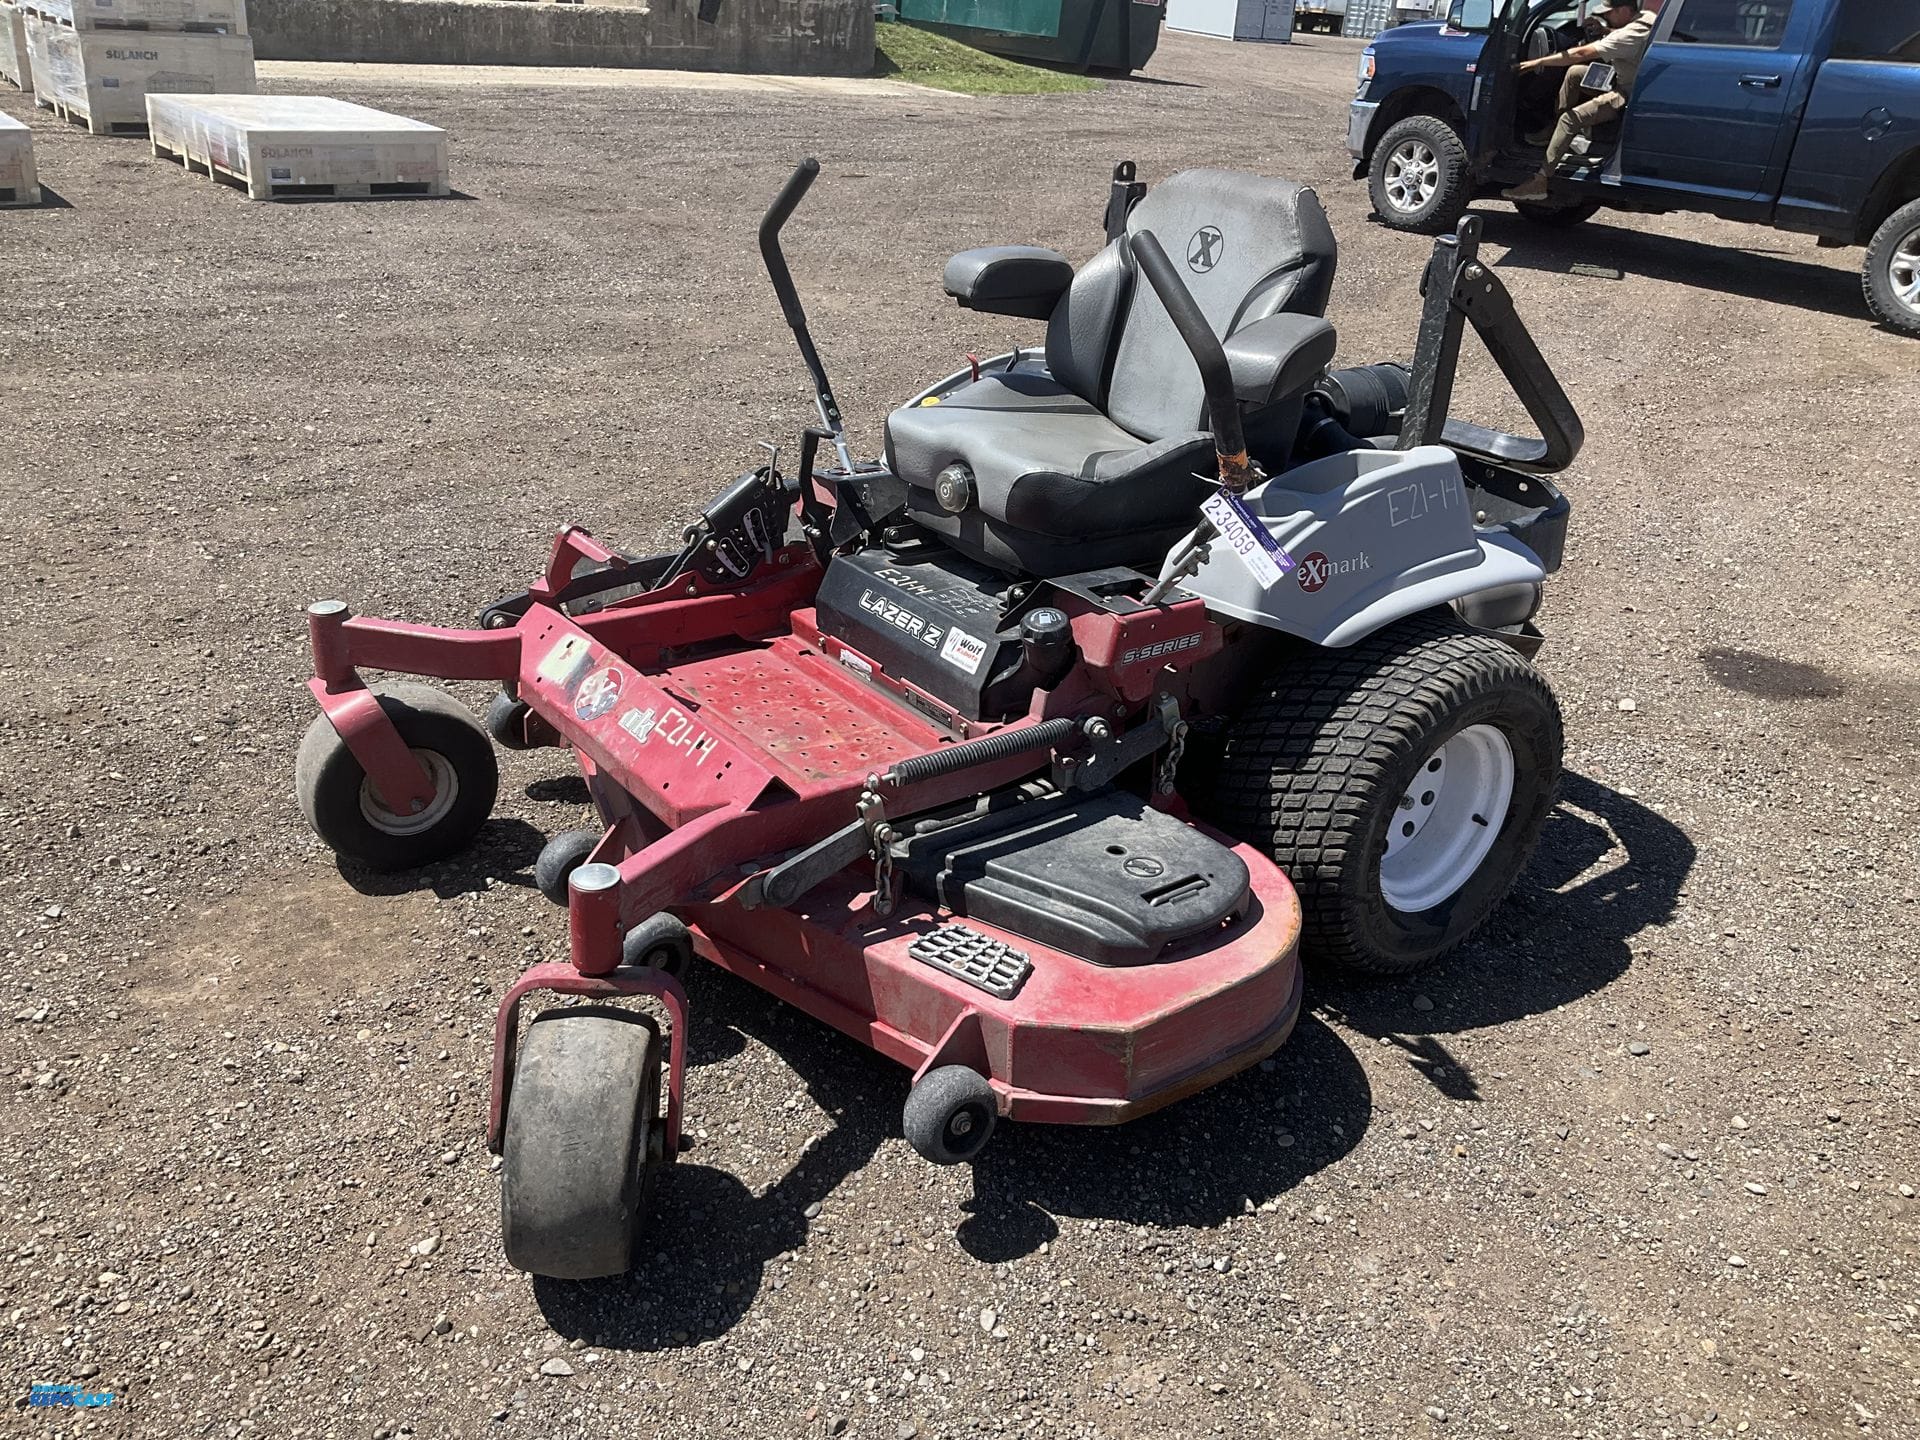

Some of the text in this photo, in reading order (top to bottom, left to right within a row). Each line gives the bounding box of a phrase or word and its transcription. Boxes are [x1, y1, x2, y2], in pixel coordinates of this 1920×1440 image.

[1205, 499, 1255, 555] 2-34059
[1387, 476, 1459, 528] E21-14
[859, 588, 926, 640] LAZER
[921, 623, 945, 649] Z
[960, 639, 983, 655] Wolf
[1121, 632, 1203, 665] S-SERIES
[655, 707, 719, 767] E21-14
